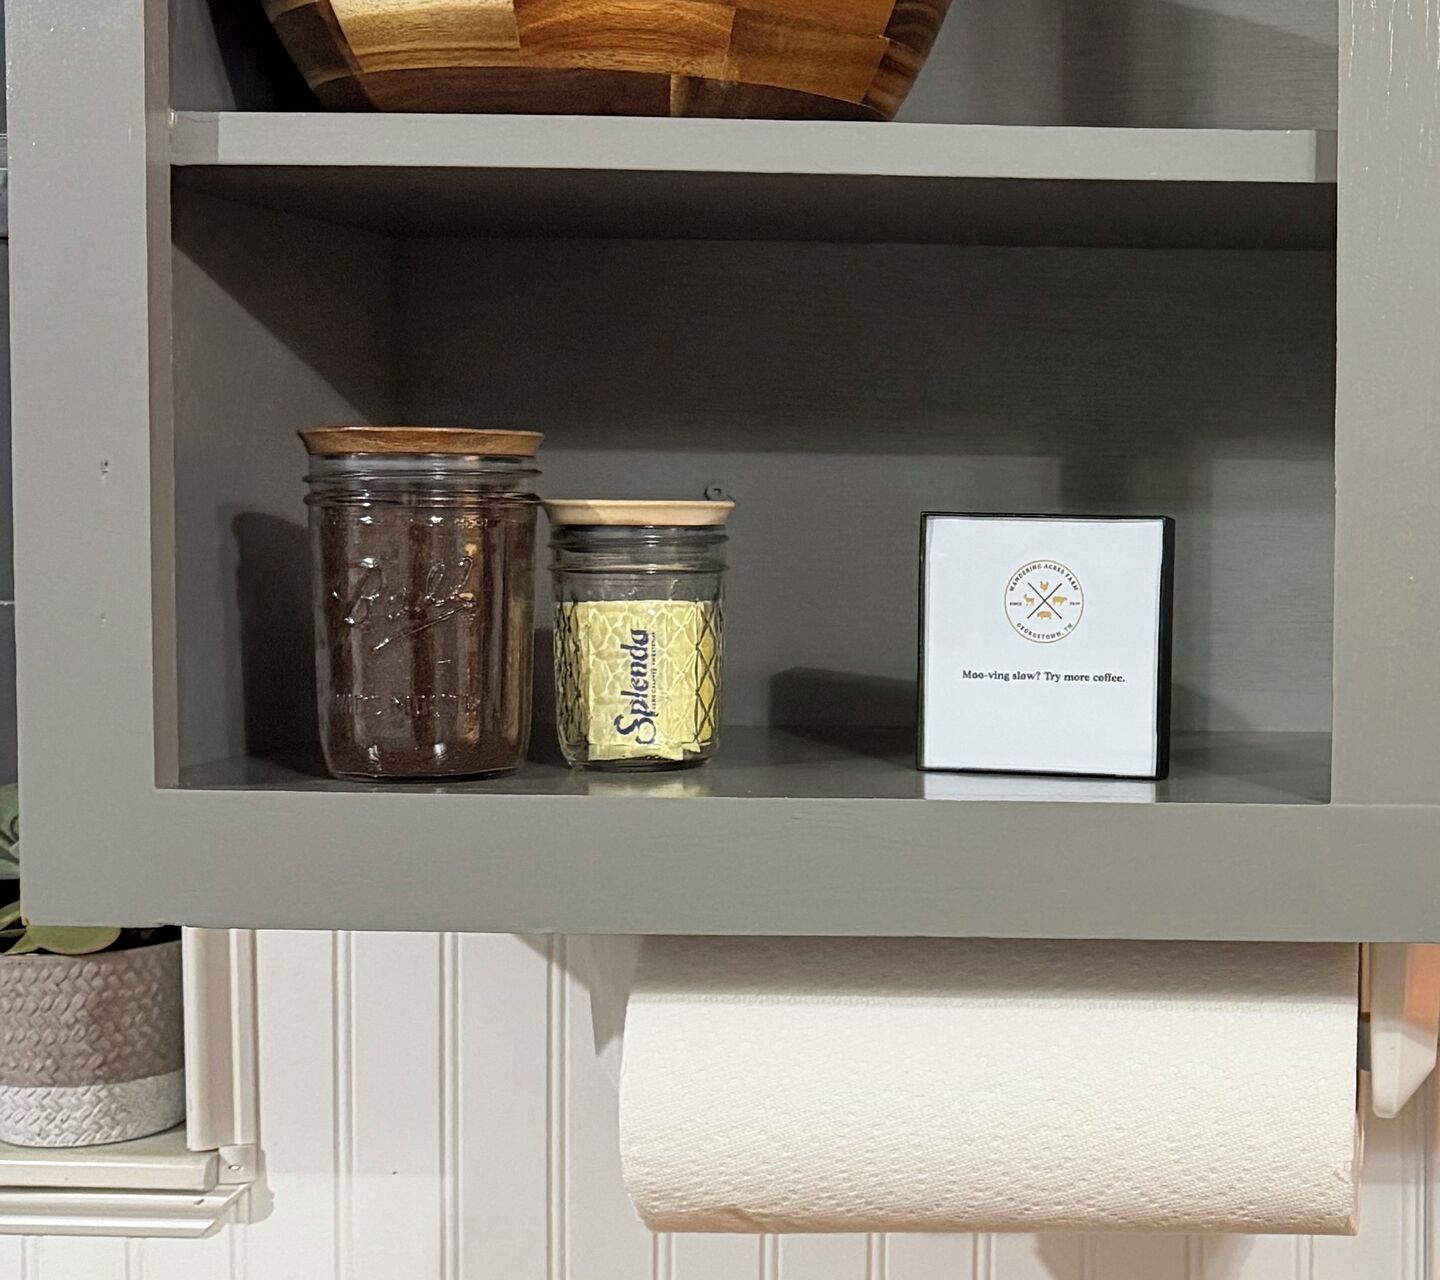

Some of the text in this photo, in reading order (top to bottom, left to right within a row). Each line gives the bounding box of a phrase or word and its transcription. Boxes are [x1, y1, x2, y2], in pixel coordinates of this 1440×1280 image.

[614, 628, 659, 744] Splenda
[962, 669, 1126, 683] Moo-ving slow? Try more coffee.
